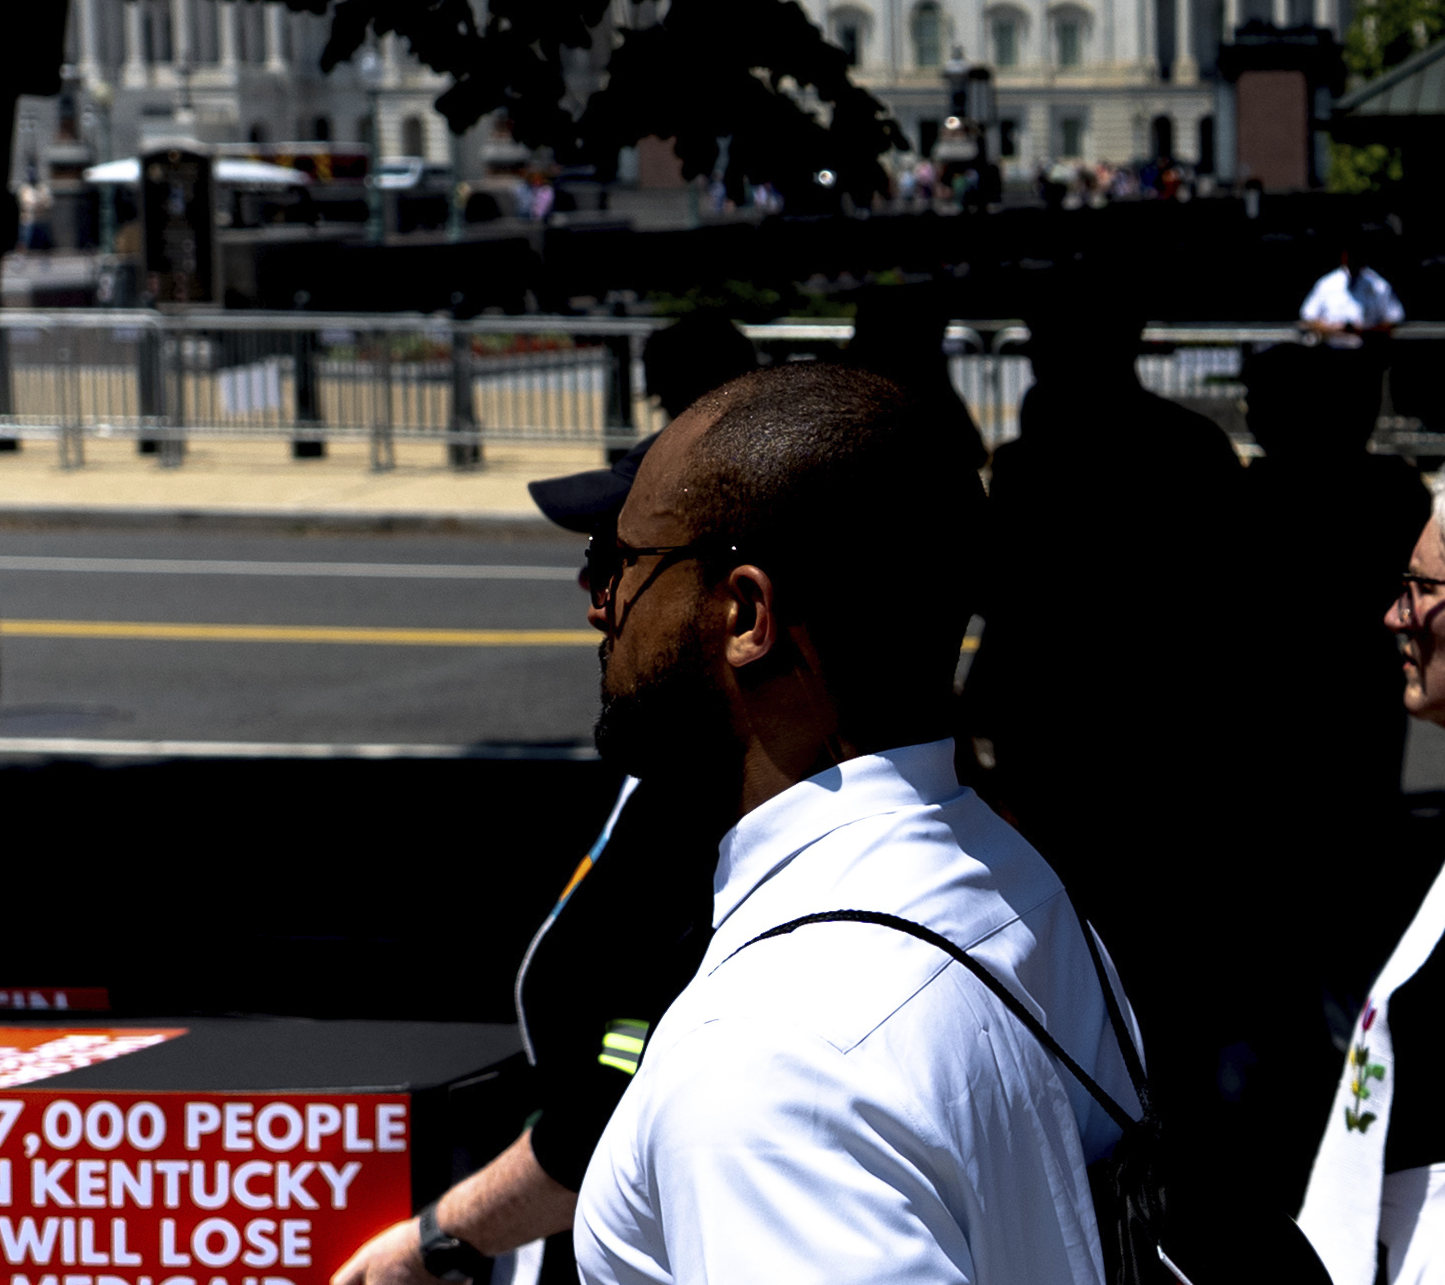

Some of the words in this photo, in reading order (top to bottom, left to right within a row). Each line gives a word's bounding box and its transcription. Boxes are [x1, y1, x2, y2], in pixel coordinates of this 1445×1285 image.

[185, 1102, 406, 1152] PEOPLE
[31, 1158, 360, 1210] KENTUCKY
[160, 1217, 311, 1268] LOSE
